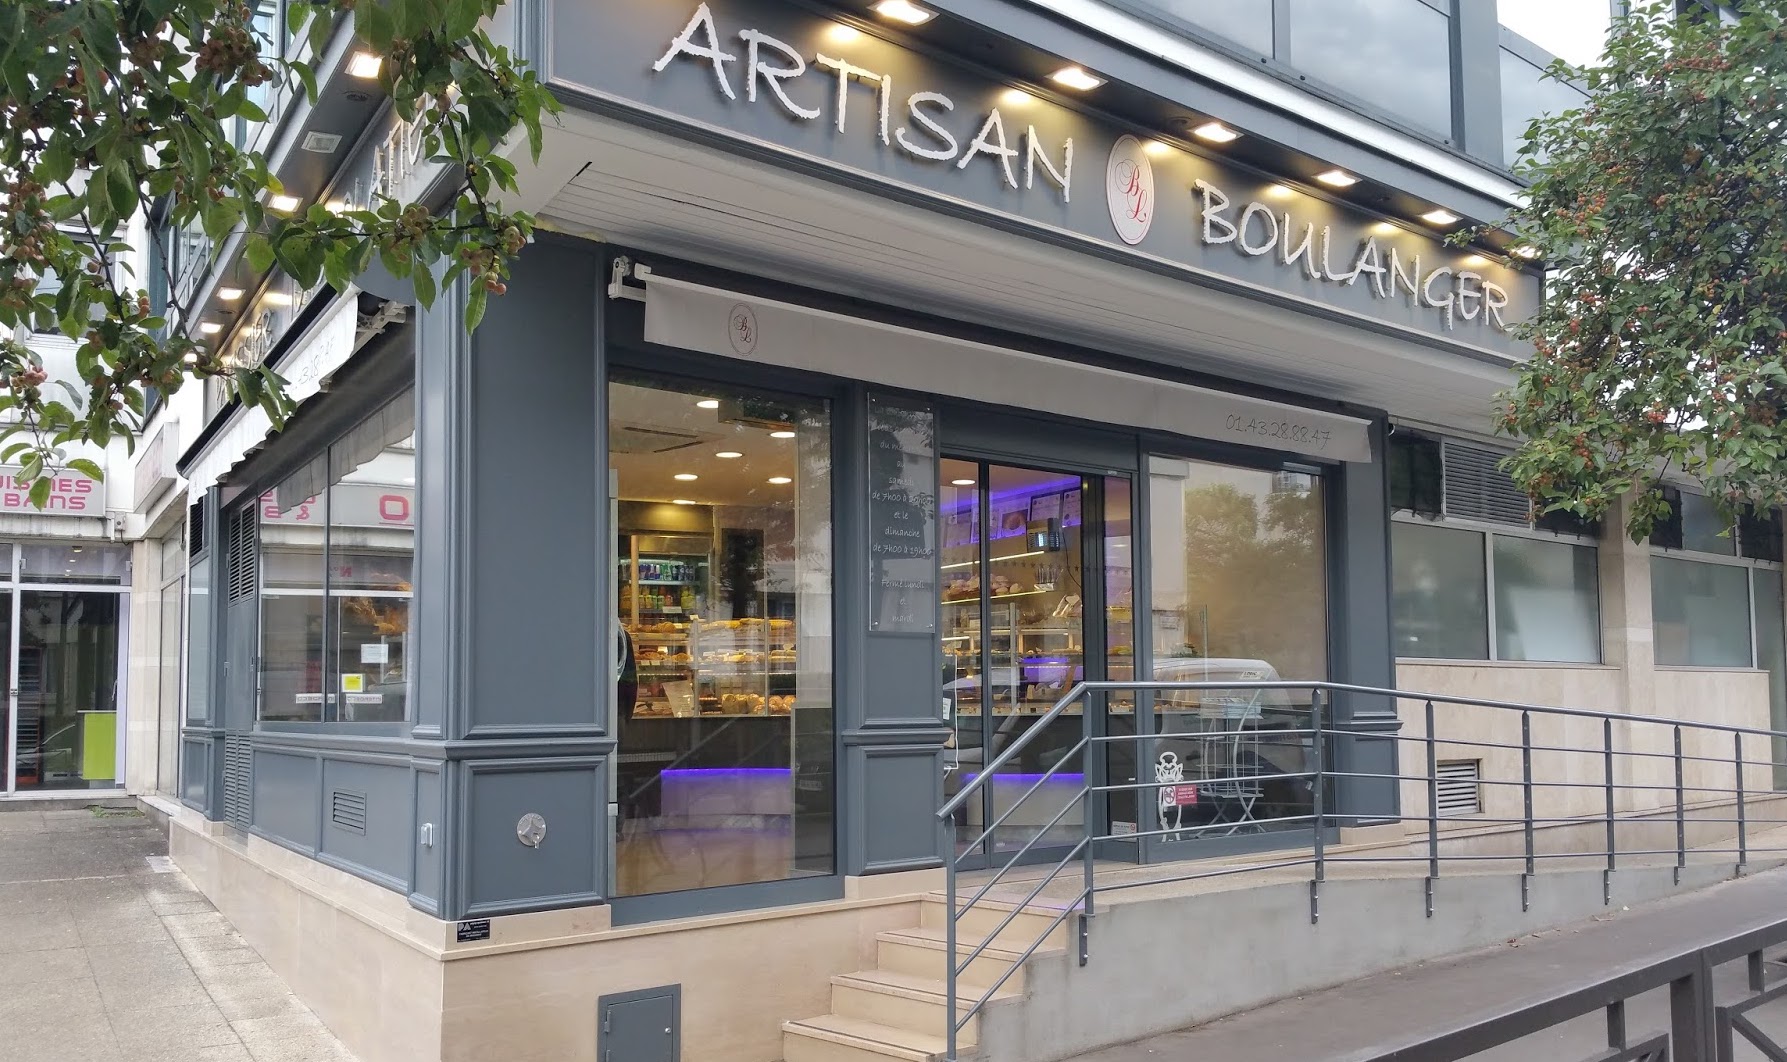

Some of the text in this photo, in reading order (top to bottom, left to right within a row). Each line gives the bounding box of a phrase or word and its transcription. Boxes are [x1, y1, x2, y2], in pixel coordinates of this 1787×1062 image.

[652, 4, 1075, 204] ARTISAN
[1193, 178, 1512, 331] BOULANGER
[1225, 414, 1331, 450] 01.43.28.88.47
[4, 493, 86, 509] BNS
[872, 491, 881, 500] de
[882, 492, 902, 502] 7h00
[885, 526, 920, 538] dimanche
[873, 543, 881, 552] de
[882, 544, 902, 554] 7h00
